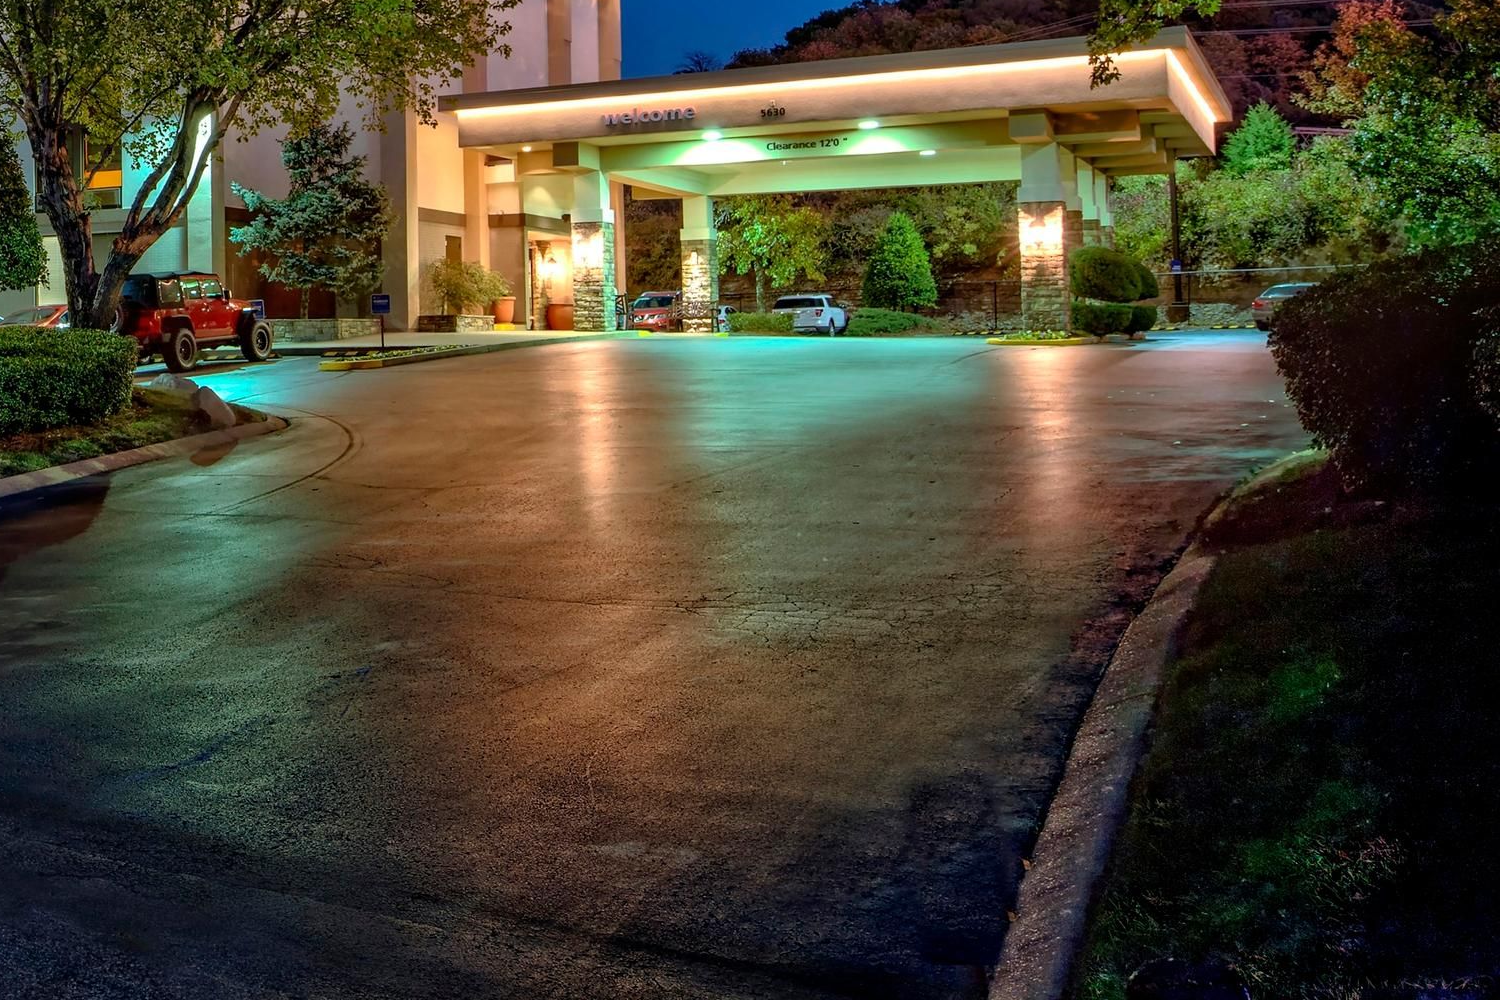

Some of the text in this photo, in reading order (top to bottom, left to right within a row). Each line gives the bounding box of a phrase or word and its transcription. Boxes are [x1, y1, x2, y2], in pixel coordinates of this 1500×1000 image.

[603, 105, 696, 126] welcome
[760, 107, 786, 118] 5630
[766, 141, 817, 151] Clearance
